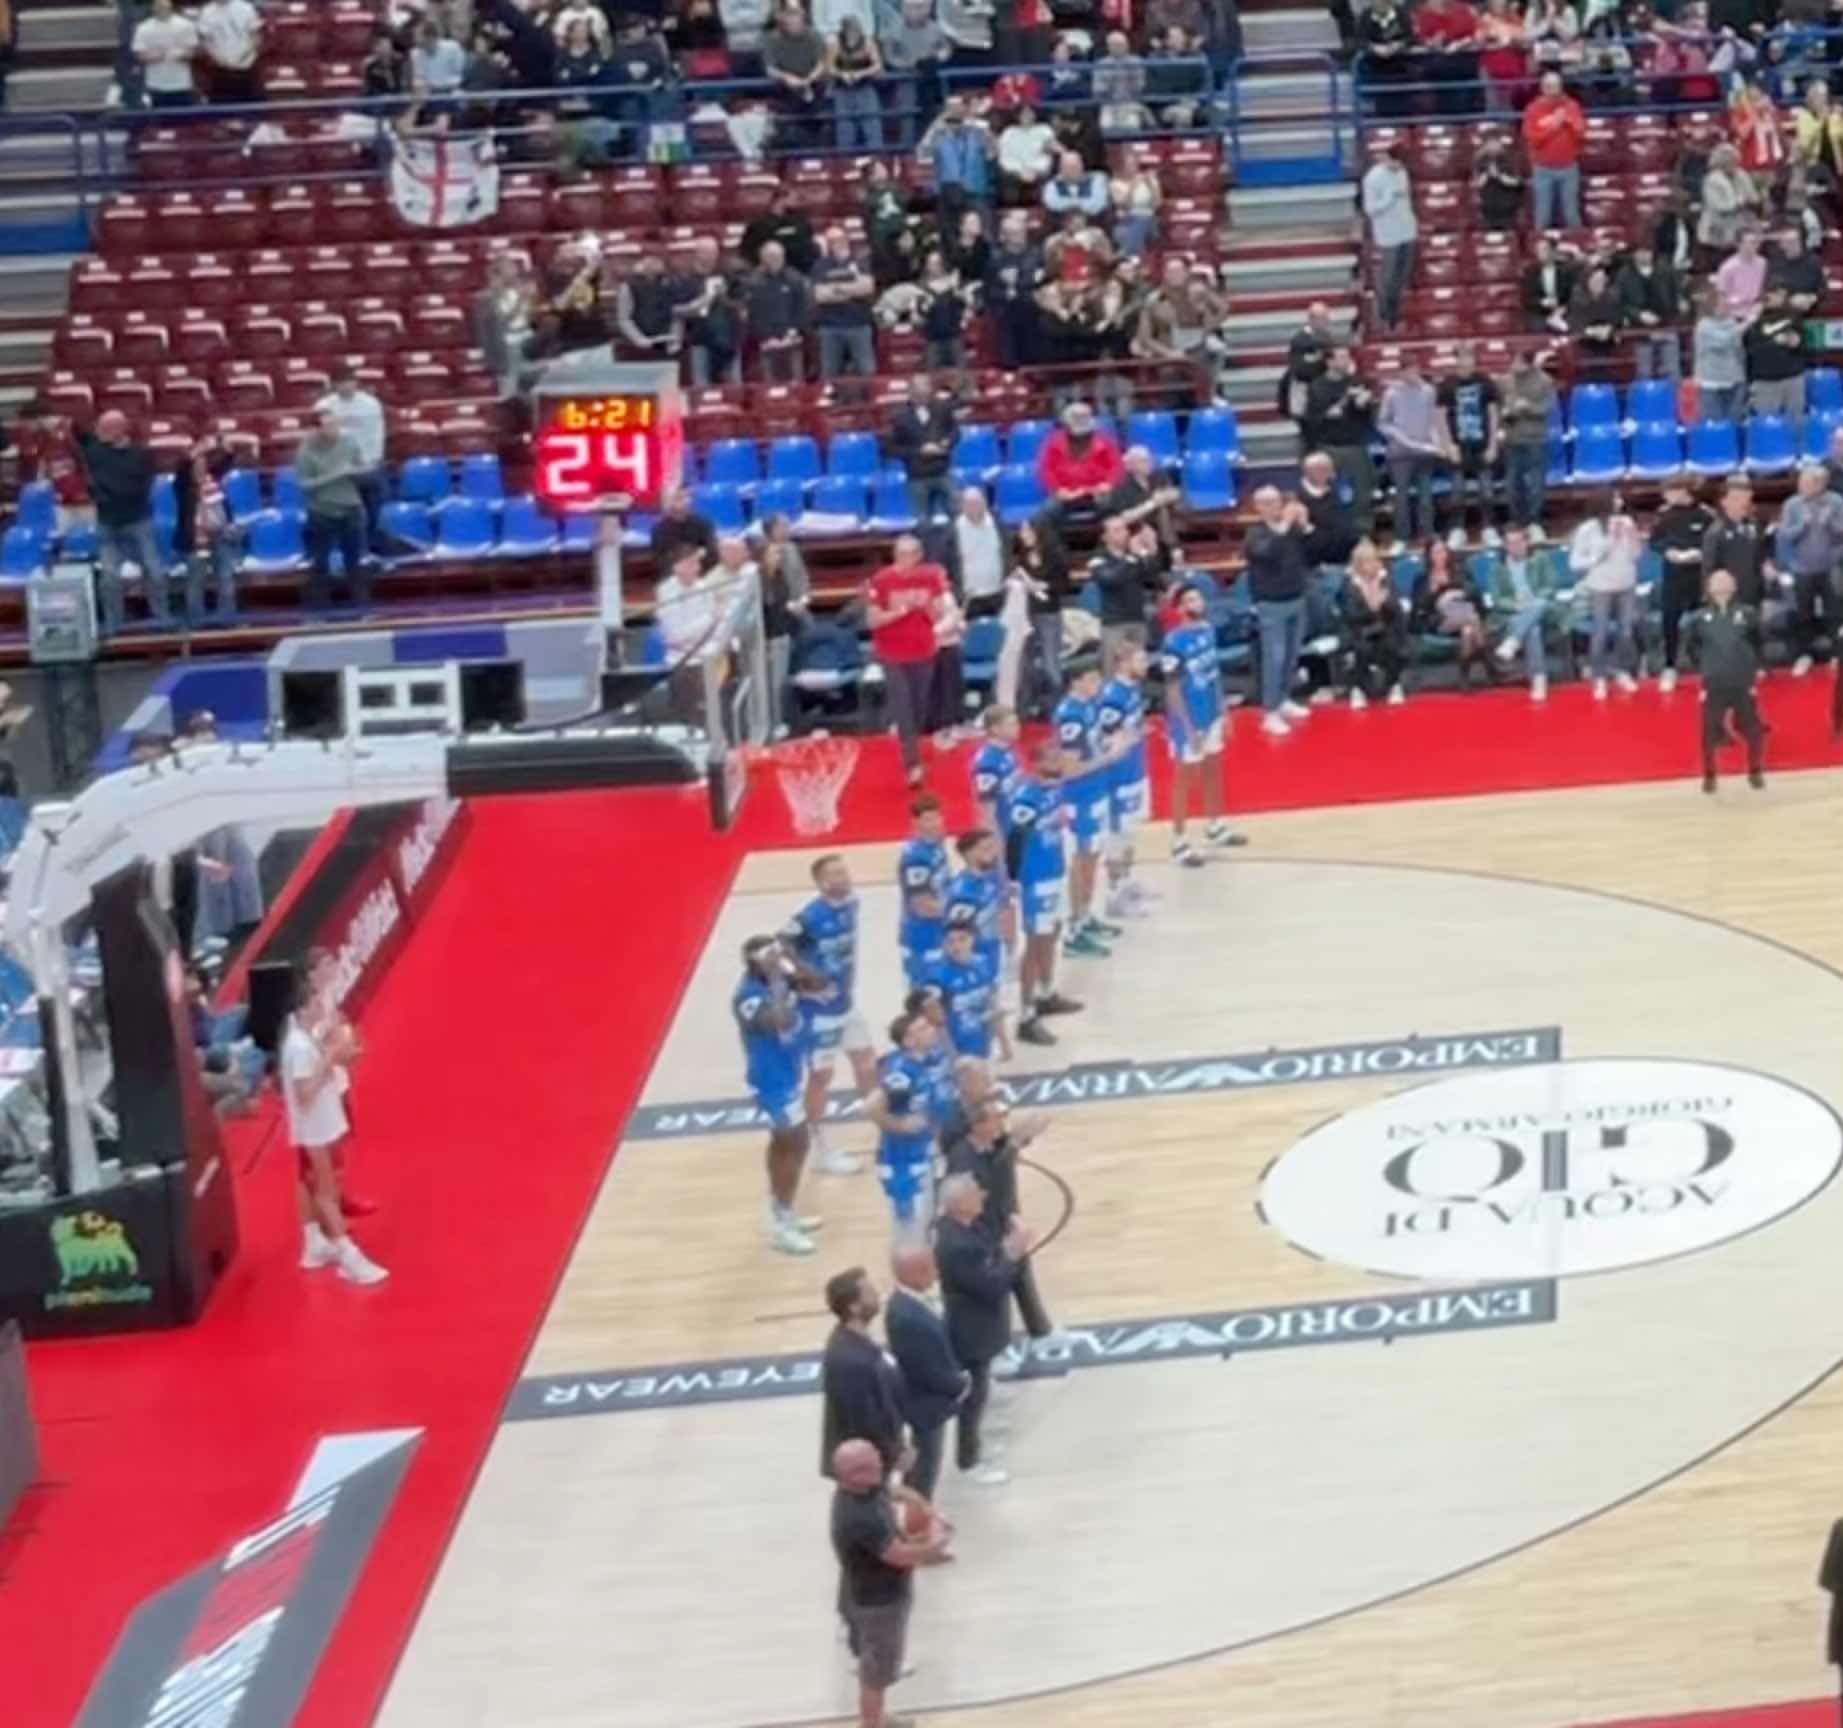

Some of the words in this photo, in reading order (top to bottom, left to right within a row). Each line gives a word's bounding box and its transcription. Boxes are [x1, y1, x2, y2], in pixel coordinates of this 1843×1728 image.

[565, 399, 651, 430] 6:21
[544, 433, 649, 494] 24
[1260, 1034, 1538, 1081] EMPORIO
[994, 1067, 1177, 1103] ARMA
[1385, 1207, 1451, 1237] DI
[1487, 1179, 1731, 1224] ACQUA
[1221, 1286, 1533, 1342] EMPORIO
[543, 1361, 824, 1404] EYEWEAR
